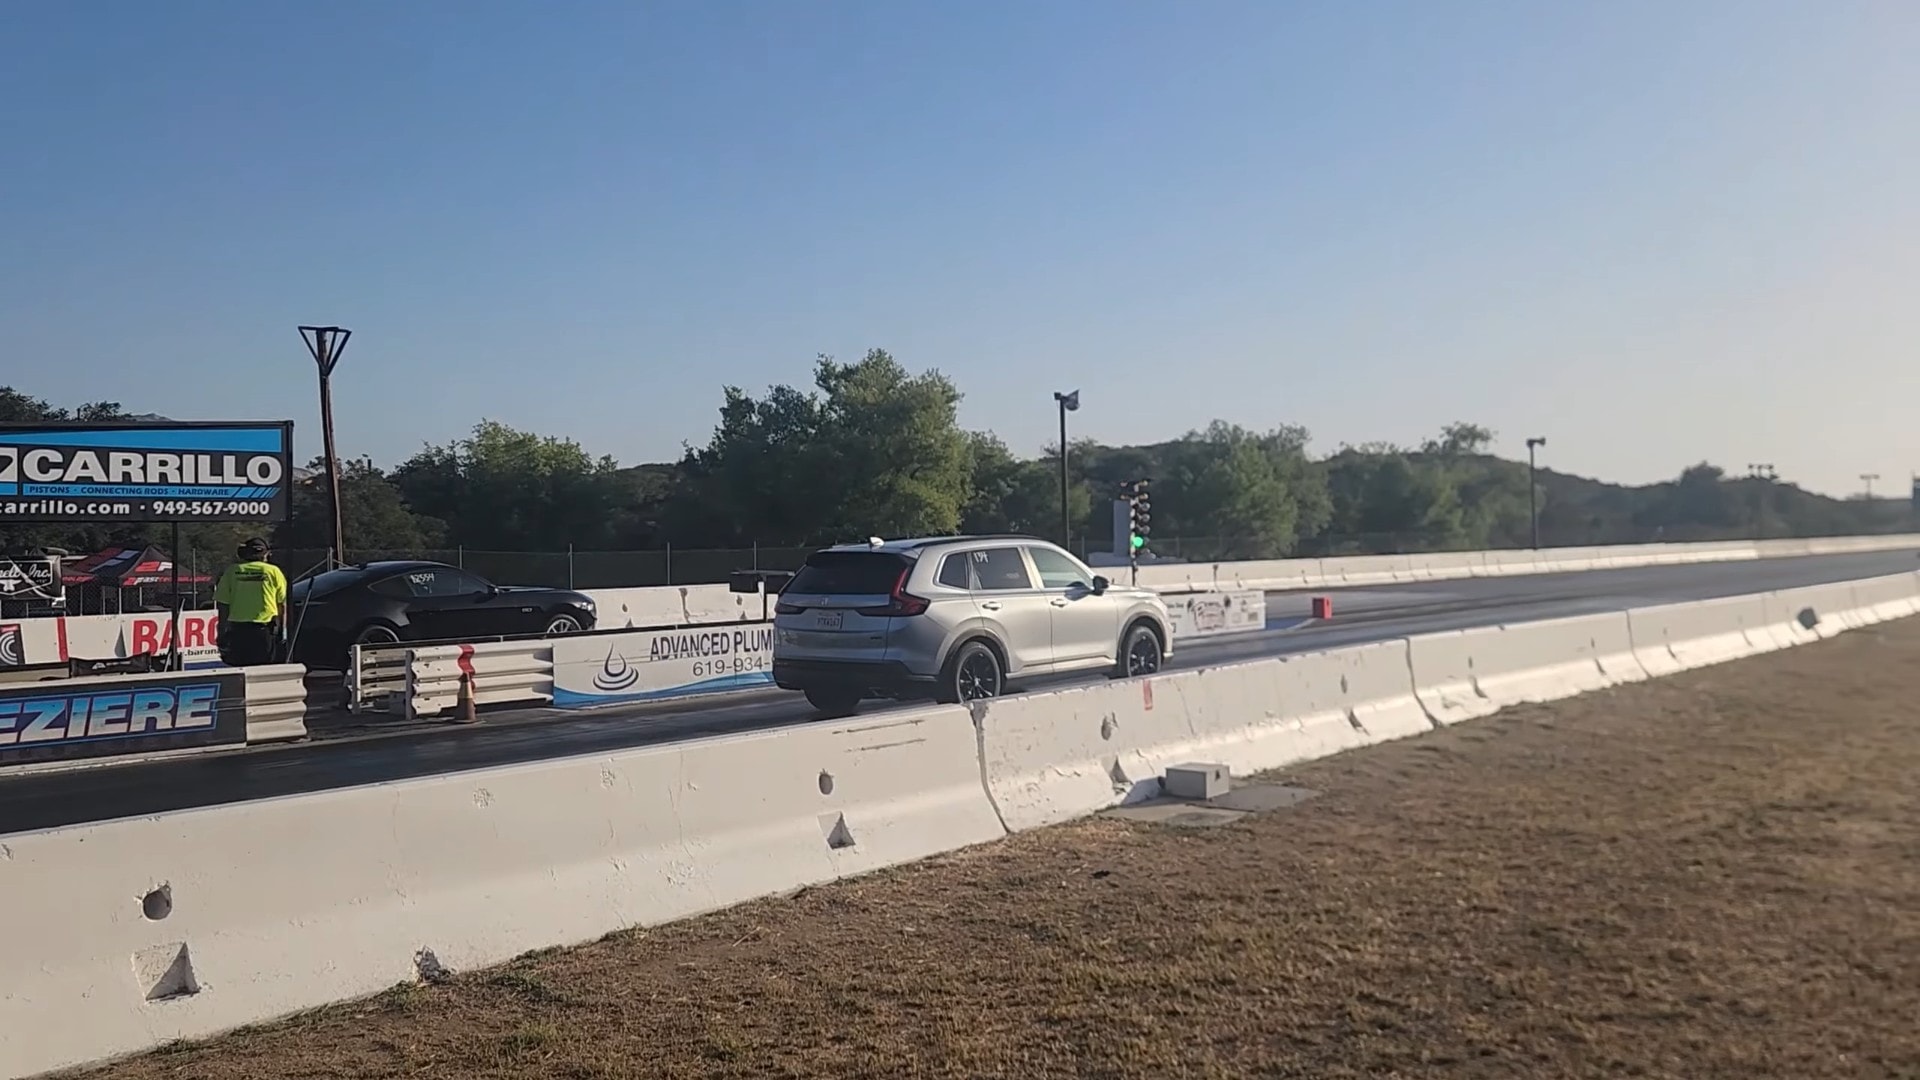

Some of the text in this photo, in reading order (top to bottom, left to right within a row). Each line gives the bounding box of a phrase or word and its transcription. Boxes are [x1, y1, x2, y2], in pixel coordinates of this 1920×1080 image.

[23, 449, 282, 486] CARRILLO
[29, 486, 70, 494] PISTONS
[81, 486, 141, 495] CONNECTING
[178, 488, 229, 496] HARDWARE
[0, 499, 270, 515] arrillo.com 949-567-9000
[650, 629, 772, 661] ADVANCED PLUM
